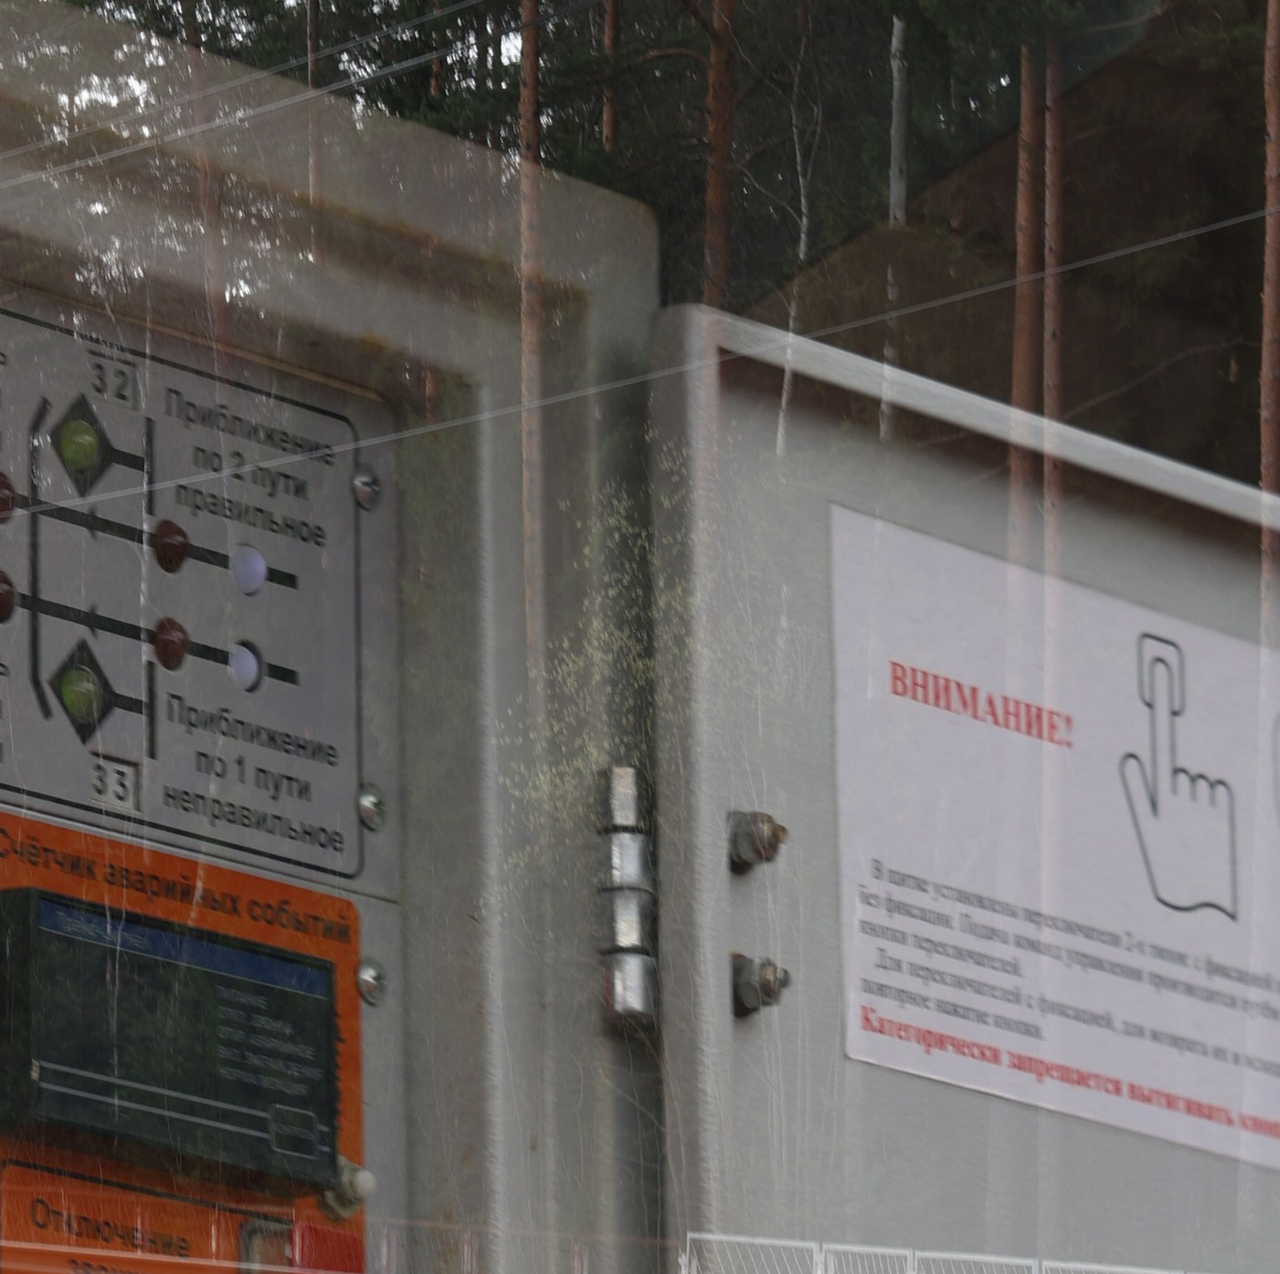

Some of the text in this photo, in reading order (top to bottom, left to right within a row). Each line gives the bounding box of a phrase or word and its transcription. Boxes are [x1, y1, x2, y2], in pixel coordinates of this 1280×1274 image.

[92, 362, 130, 402] 32
[166, 389, 336, 466] Приближение
[193, 442, 309, 501] по 2 пути
[174, 483, 327, 547] правильное
[166, 694, 339, 767] Приближение
[888, 660, 1074, 749] ВНИМАНИЕ!
[92, 764, 130, 803] 33
[195, 749, 312, 802] по 1 пути
[163, 784, 345, 853] неправильное
[104, 859, 241, 917] аварийных
[247, 898, 351, 944] событий
[30, 1196, 191, 1258] Отключение
